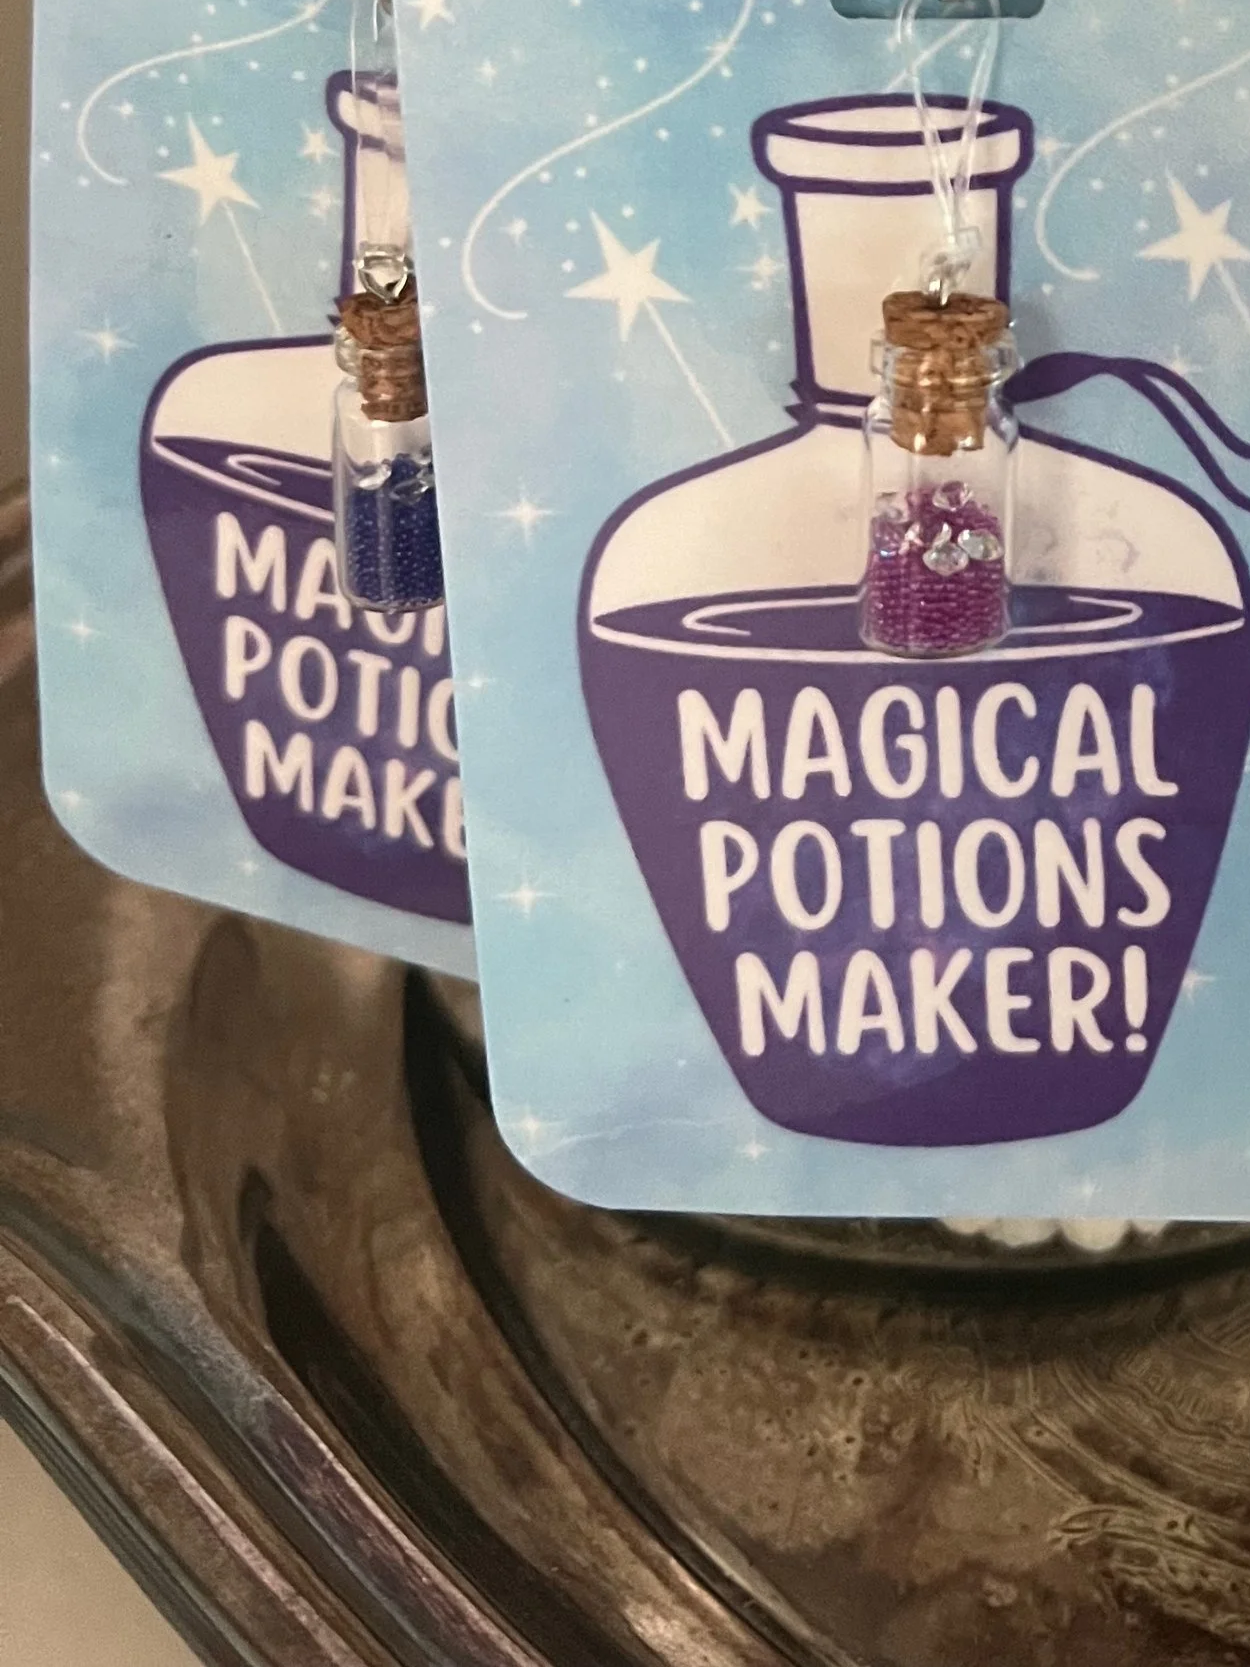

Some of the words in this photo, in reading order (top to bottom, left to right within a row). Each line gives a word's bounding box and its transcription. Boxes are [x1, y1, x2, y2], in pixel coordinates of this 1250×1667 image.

[677, 682, 1179, 801] MAGICAL
[699, 817, 1171, 932] POTIONS
[735, 945, 1149, 1056] MAKER!
